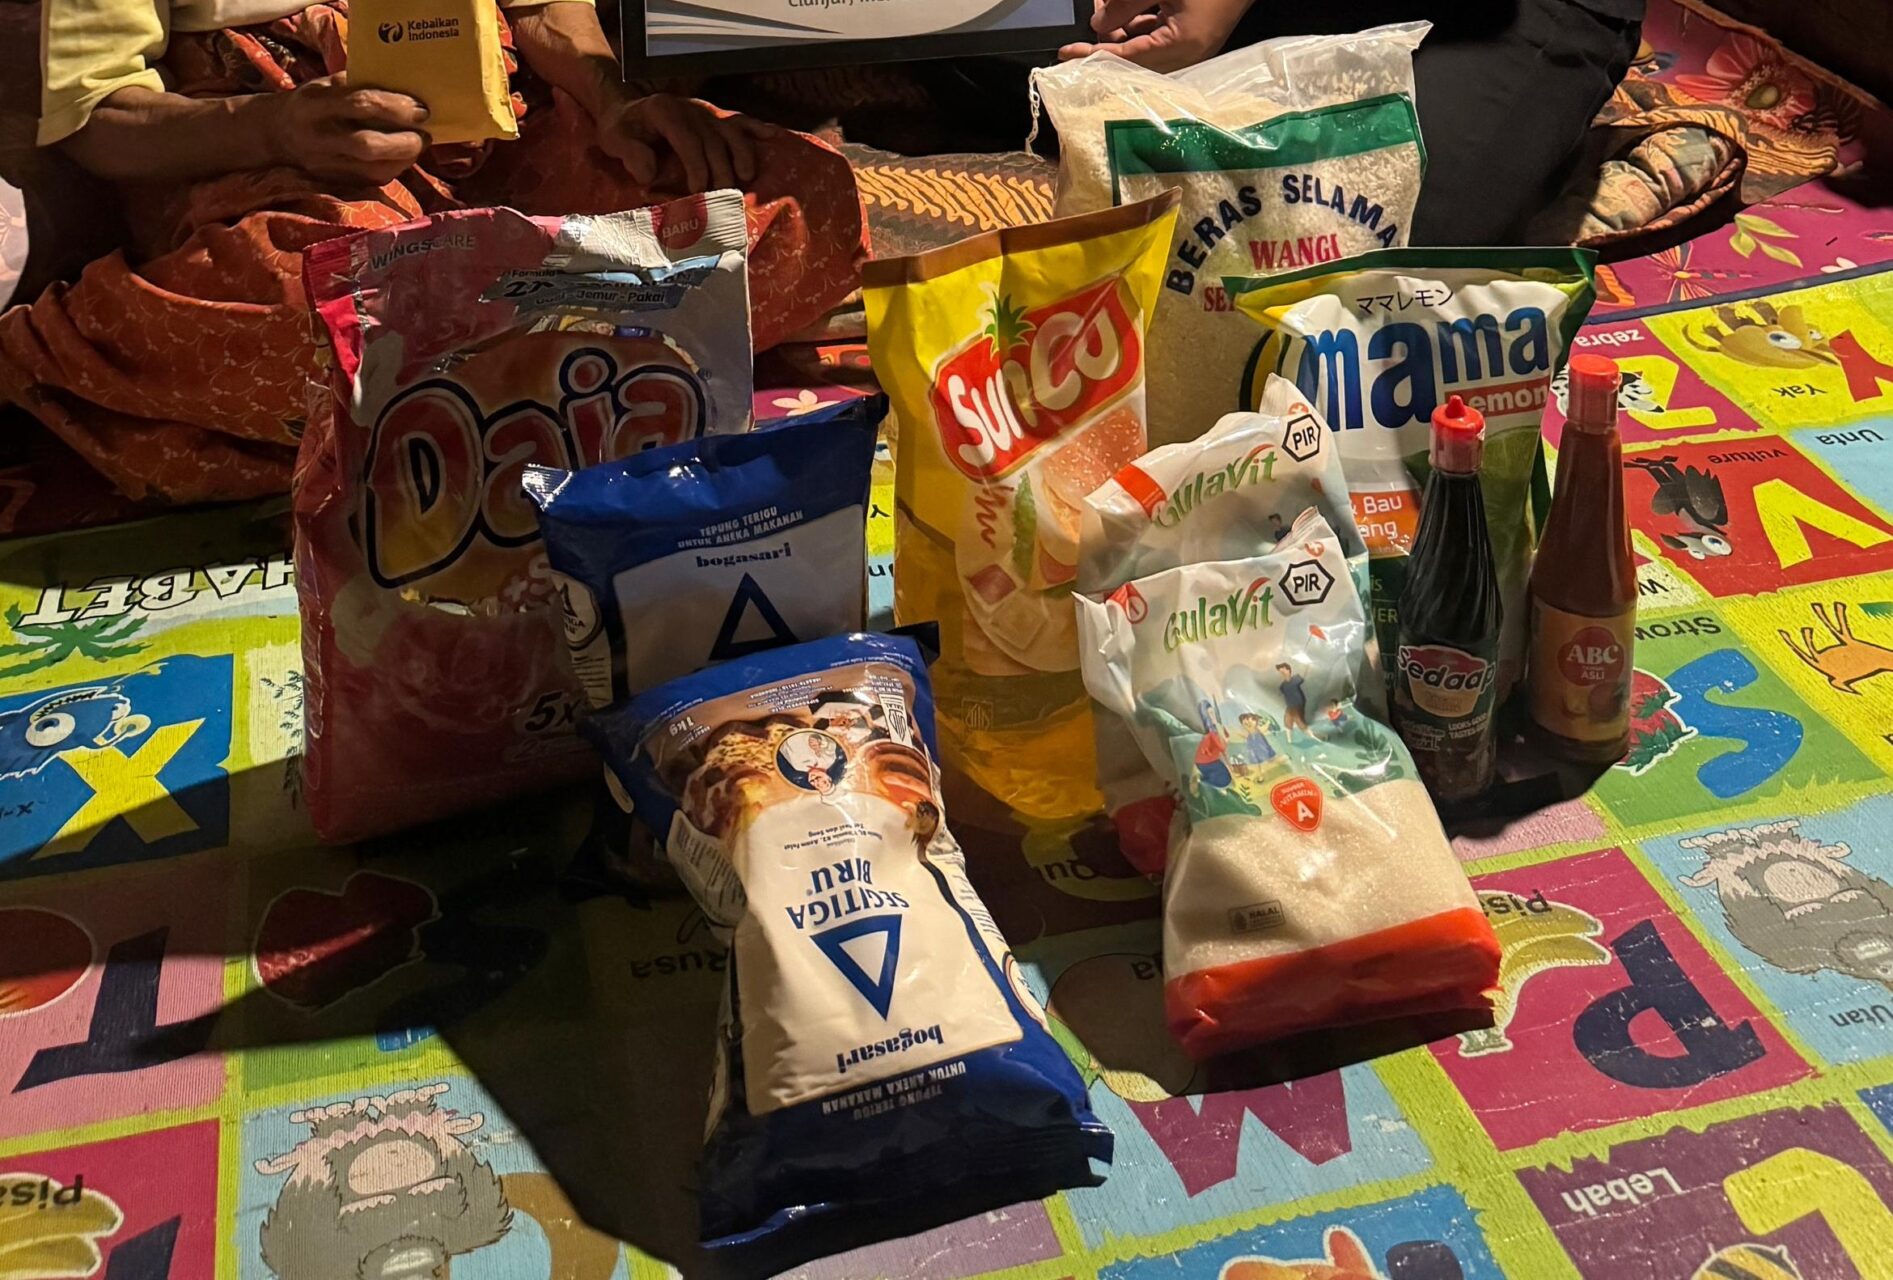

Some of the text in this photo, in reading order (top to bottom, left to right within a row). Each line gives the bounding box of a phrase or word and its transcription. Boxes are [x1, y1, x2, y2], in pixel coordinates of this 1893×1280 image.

[407, 17, 459, 32] Kebaikan
[407, 27, 459, 41] Indonesia
[661, 217, 699, 240] BARU
[1166, 185, 1262, 297] BERAS
[1249, 233, 1342, 270] WANGI
[628, 291, 665, 304] Pakai
[1356, 288, 1454, 315] ママレモン
[1575, 328, 1646, 349] zebra
[1296, 306, 1551, 433] mama
[1469, 385, 1548, 413] emon
[1771, 383, 1829, 399] Yak
[1293, 425, 1318, 451] PIR
[1816, 428, 1886, 446] Unta
[1707, 447, 1792, 465] vulture
[1363, 495, 1402, 514] Bau
[677, 510, 804, 549] UNTUK ANEKA MAKANAN
[699, 506, 779, 538] TEPUNG TERIGU
[696, 542, 792, 568] bogasari
[1293, 574, 1321, 594] PIR
[1566, 644, 1619, 665] ABC
[1581, 670, 1605, 680] ASLI
[1663, 648, 1805, 799] S
[27, 717, 207, 862] X
[1296, 800, 1315, 822] A
[812, 857, 872, 893] BIRU
[784, 888, 910, 930] SEGITIGA
[12, 926, 216, 1095] T
[1573, 919, 1767, 1089] P
[836, 1024, 944, 1073] bogasari
[821, 1061, 966, 1115] UNTUK ANEKA MAKANAN
[1561, 1167, 1686, 1216] Lebah
